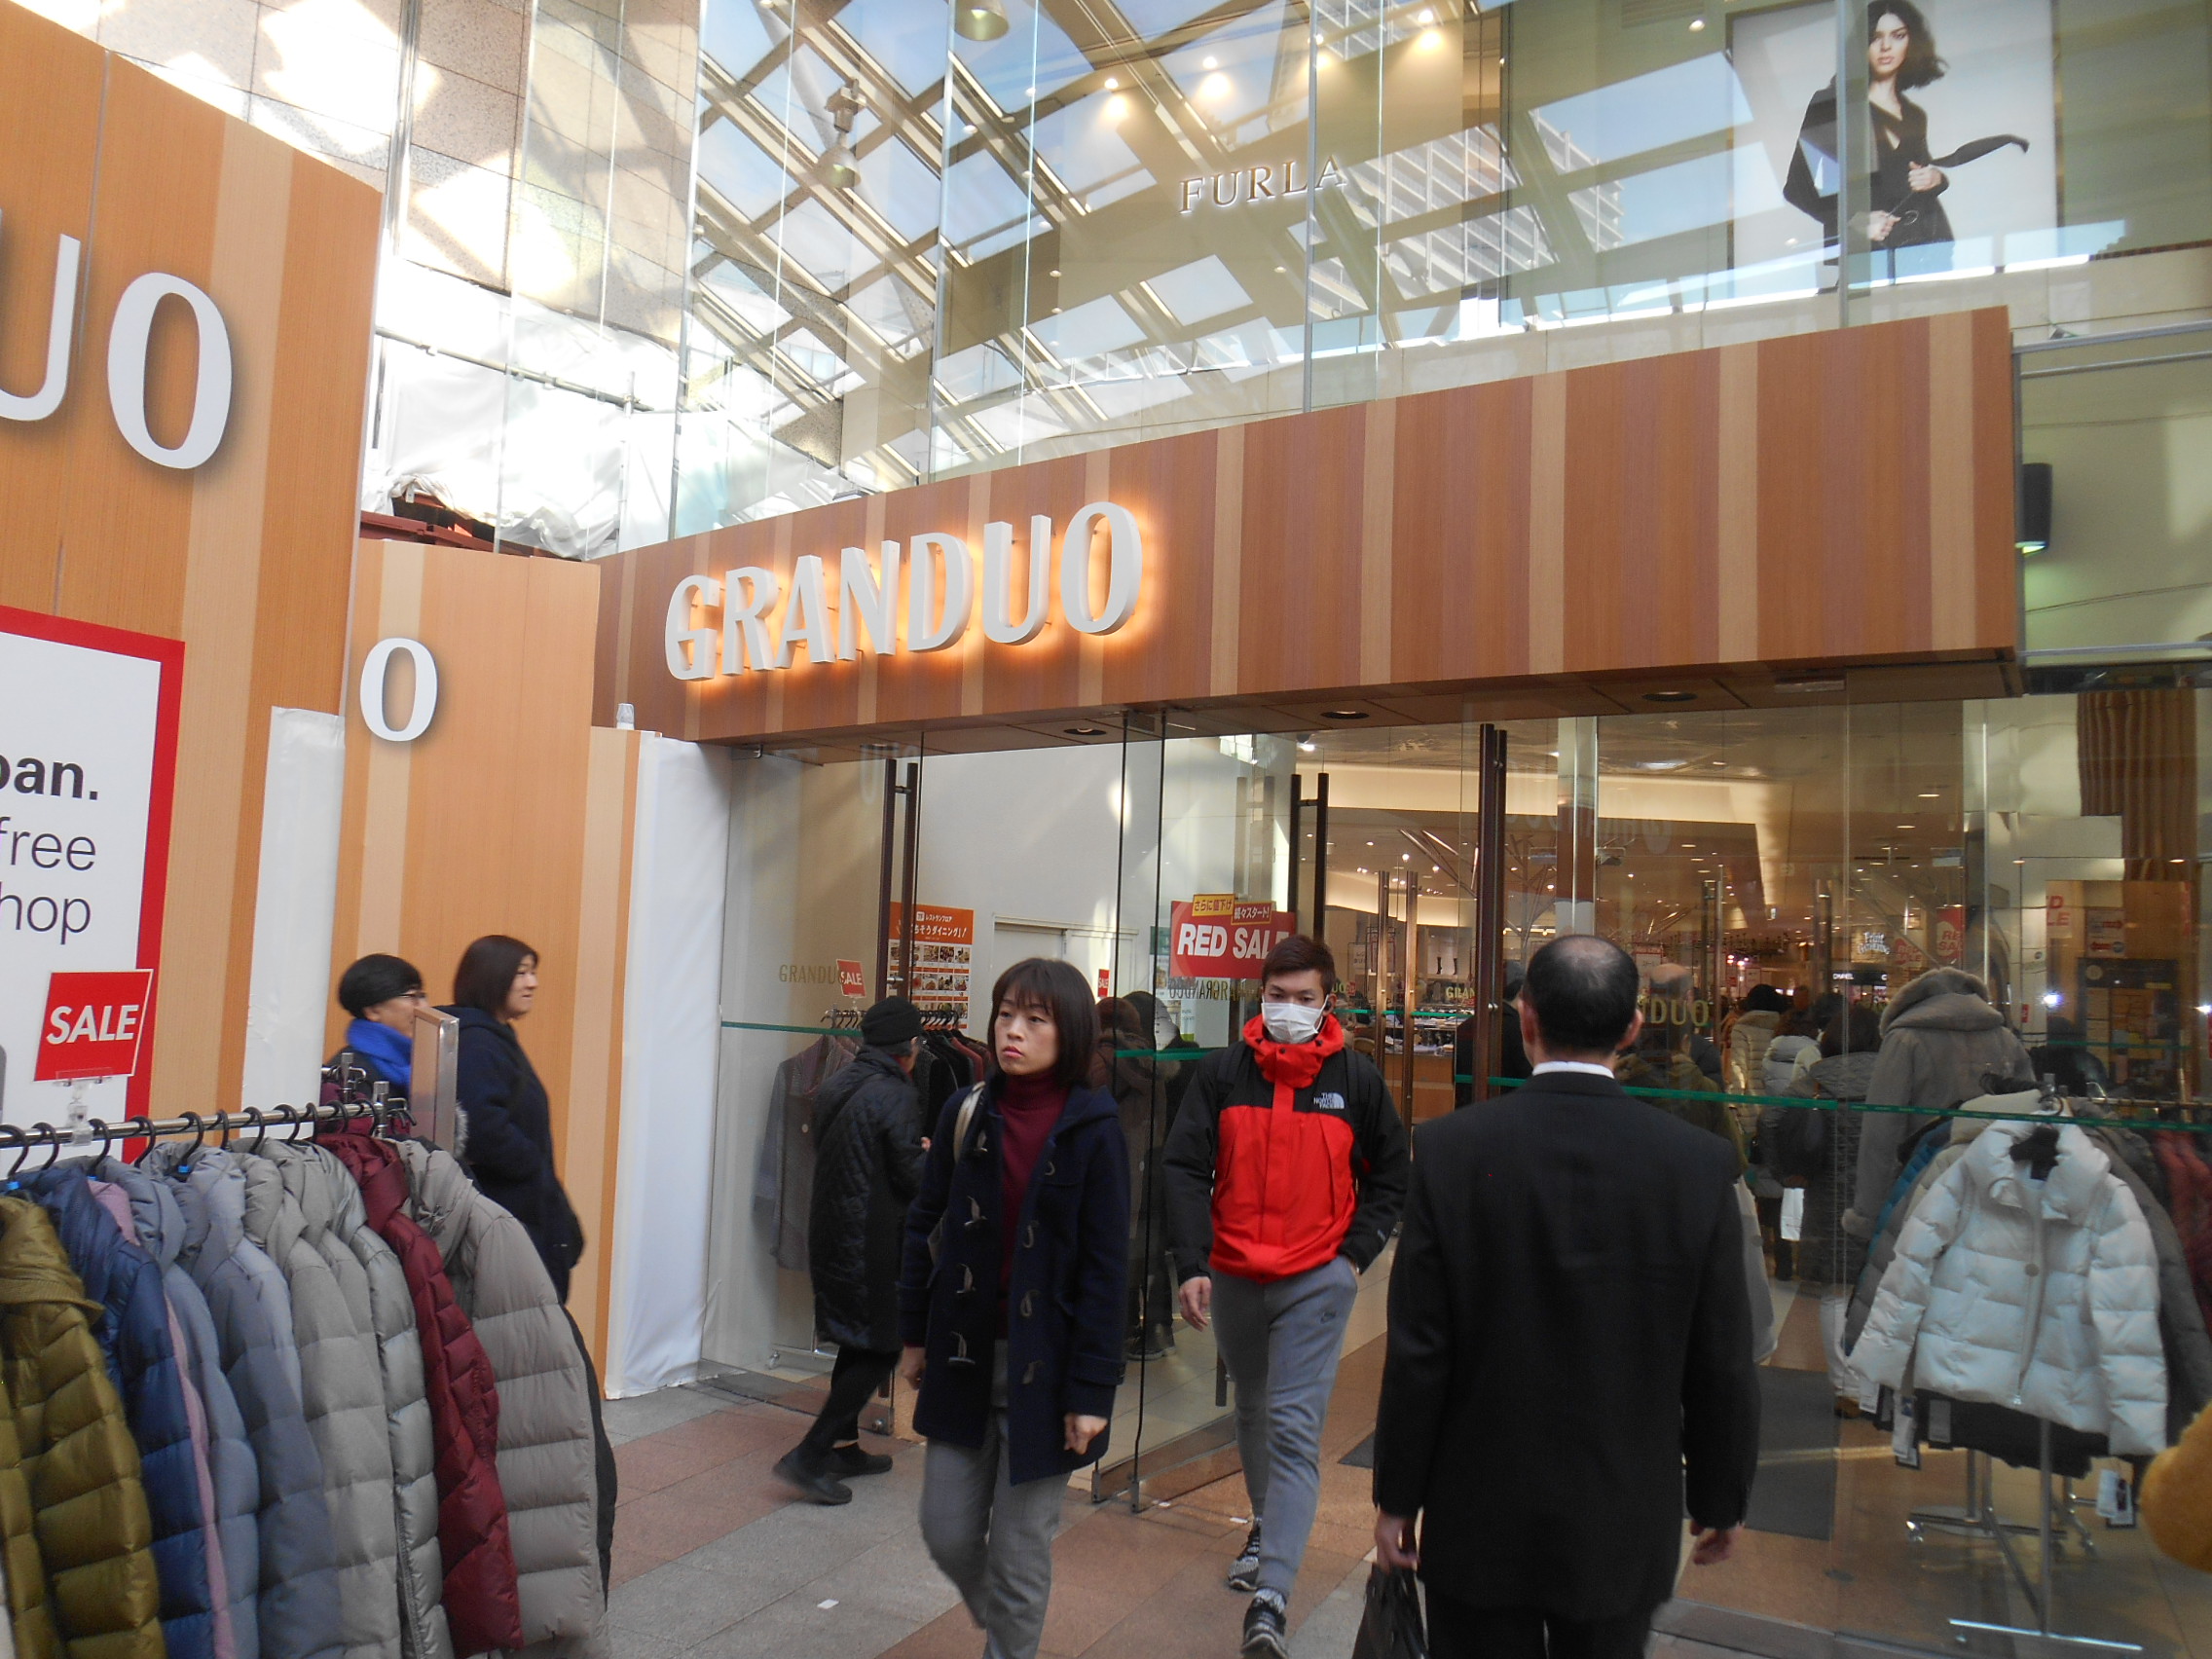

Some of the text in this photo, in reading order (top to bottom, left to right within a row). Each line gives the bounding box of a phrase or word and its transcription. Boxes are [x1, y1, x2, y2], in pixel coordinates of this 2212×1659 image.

[1179, 154, 1348, 214] FURLA
[665, 501, 1143, 682] GRANDUO
[1177, 923, 1228, 957] RED
[840, 971, 863, 985] SALE
[46, 1005, 139, 1045] SALE
